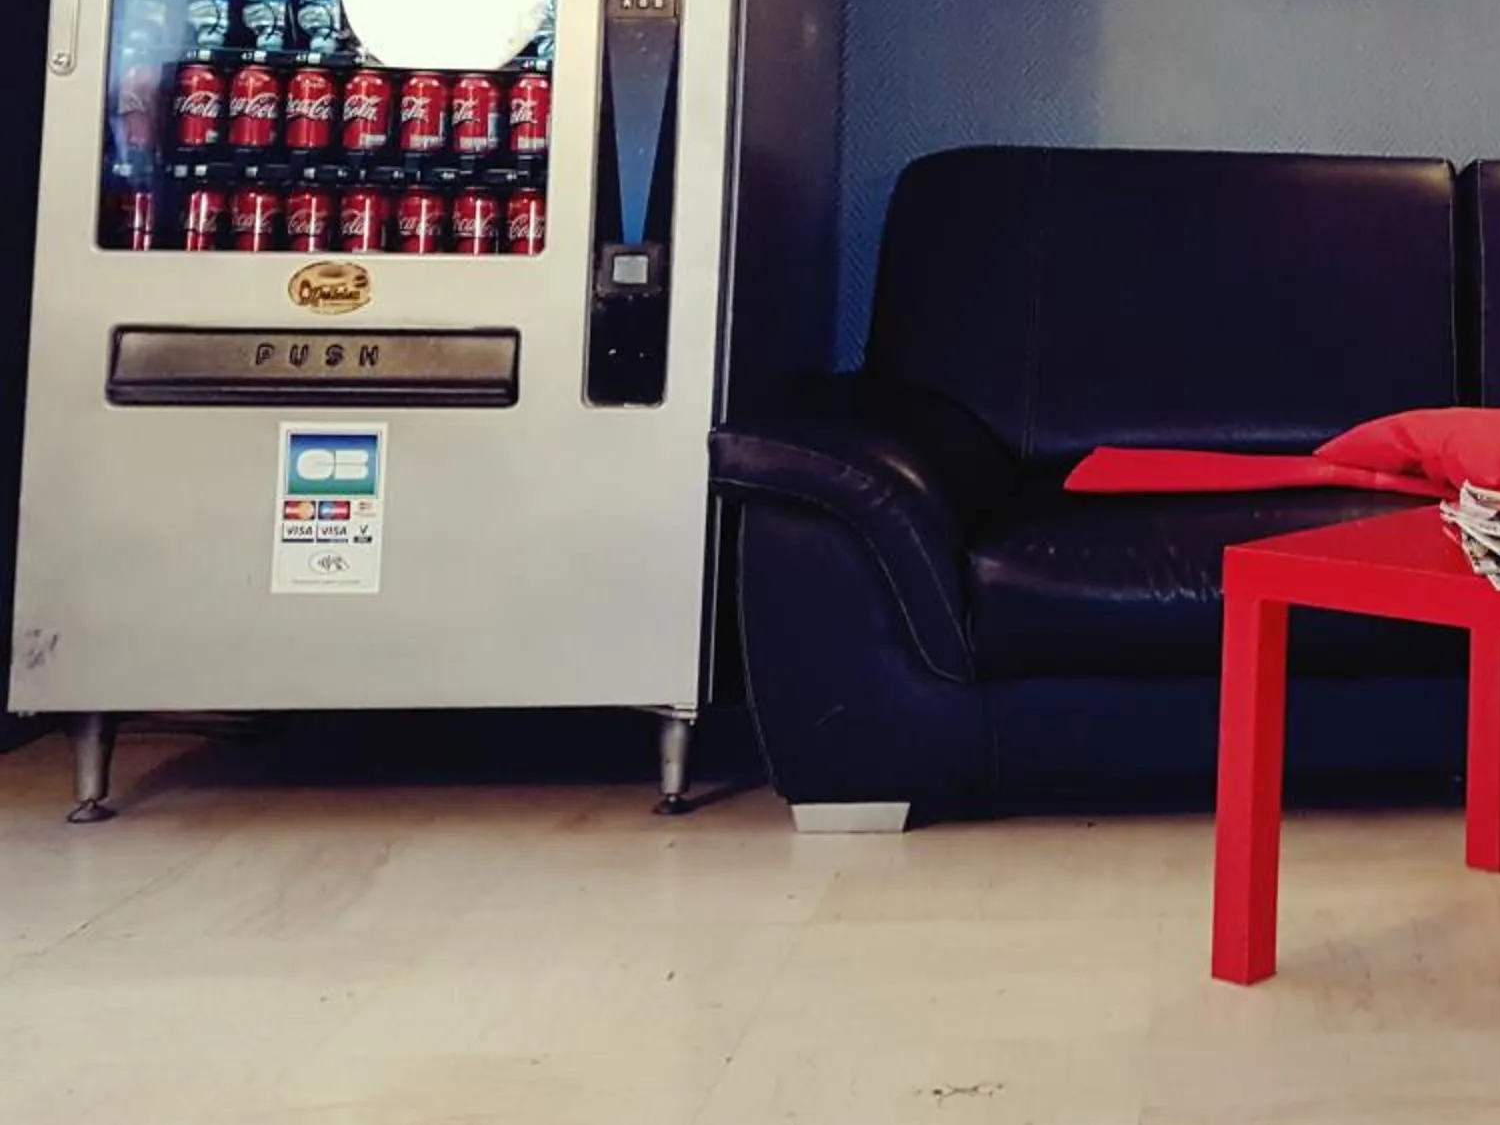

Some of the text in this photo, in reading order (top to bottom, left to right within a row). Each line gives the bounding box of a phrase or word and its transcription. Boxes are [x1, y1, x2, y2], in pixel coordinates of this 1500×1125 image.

[255, 342, 380, 367] PUSH
[296, 448, 369, 481] CB
[287, 526, 313, 536] VISA
[321, 526, 347, 536] VISA
